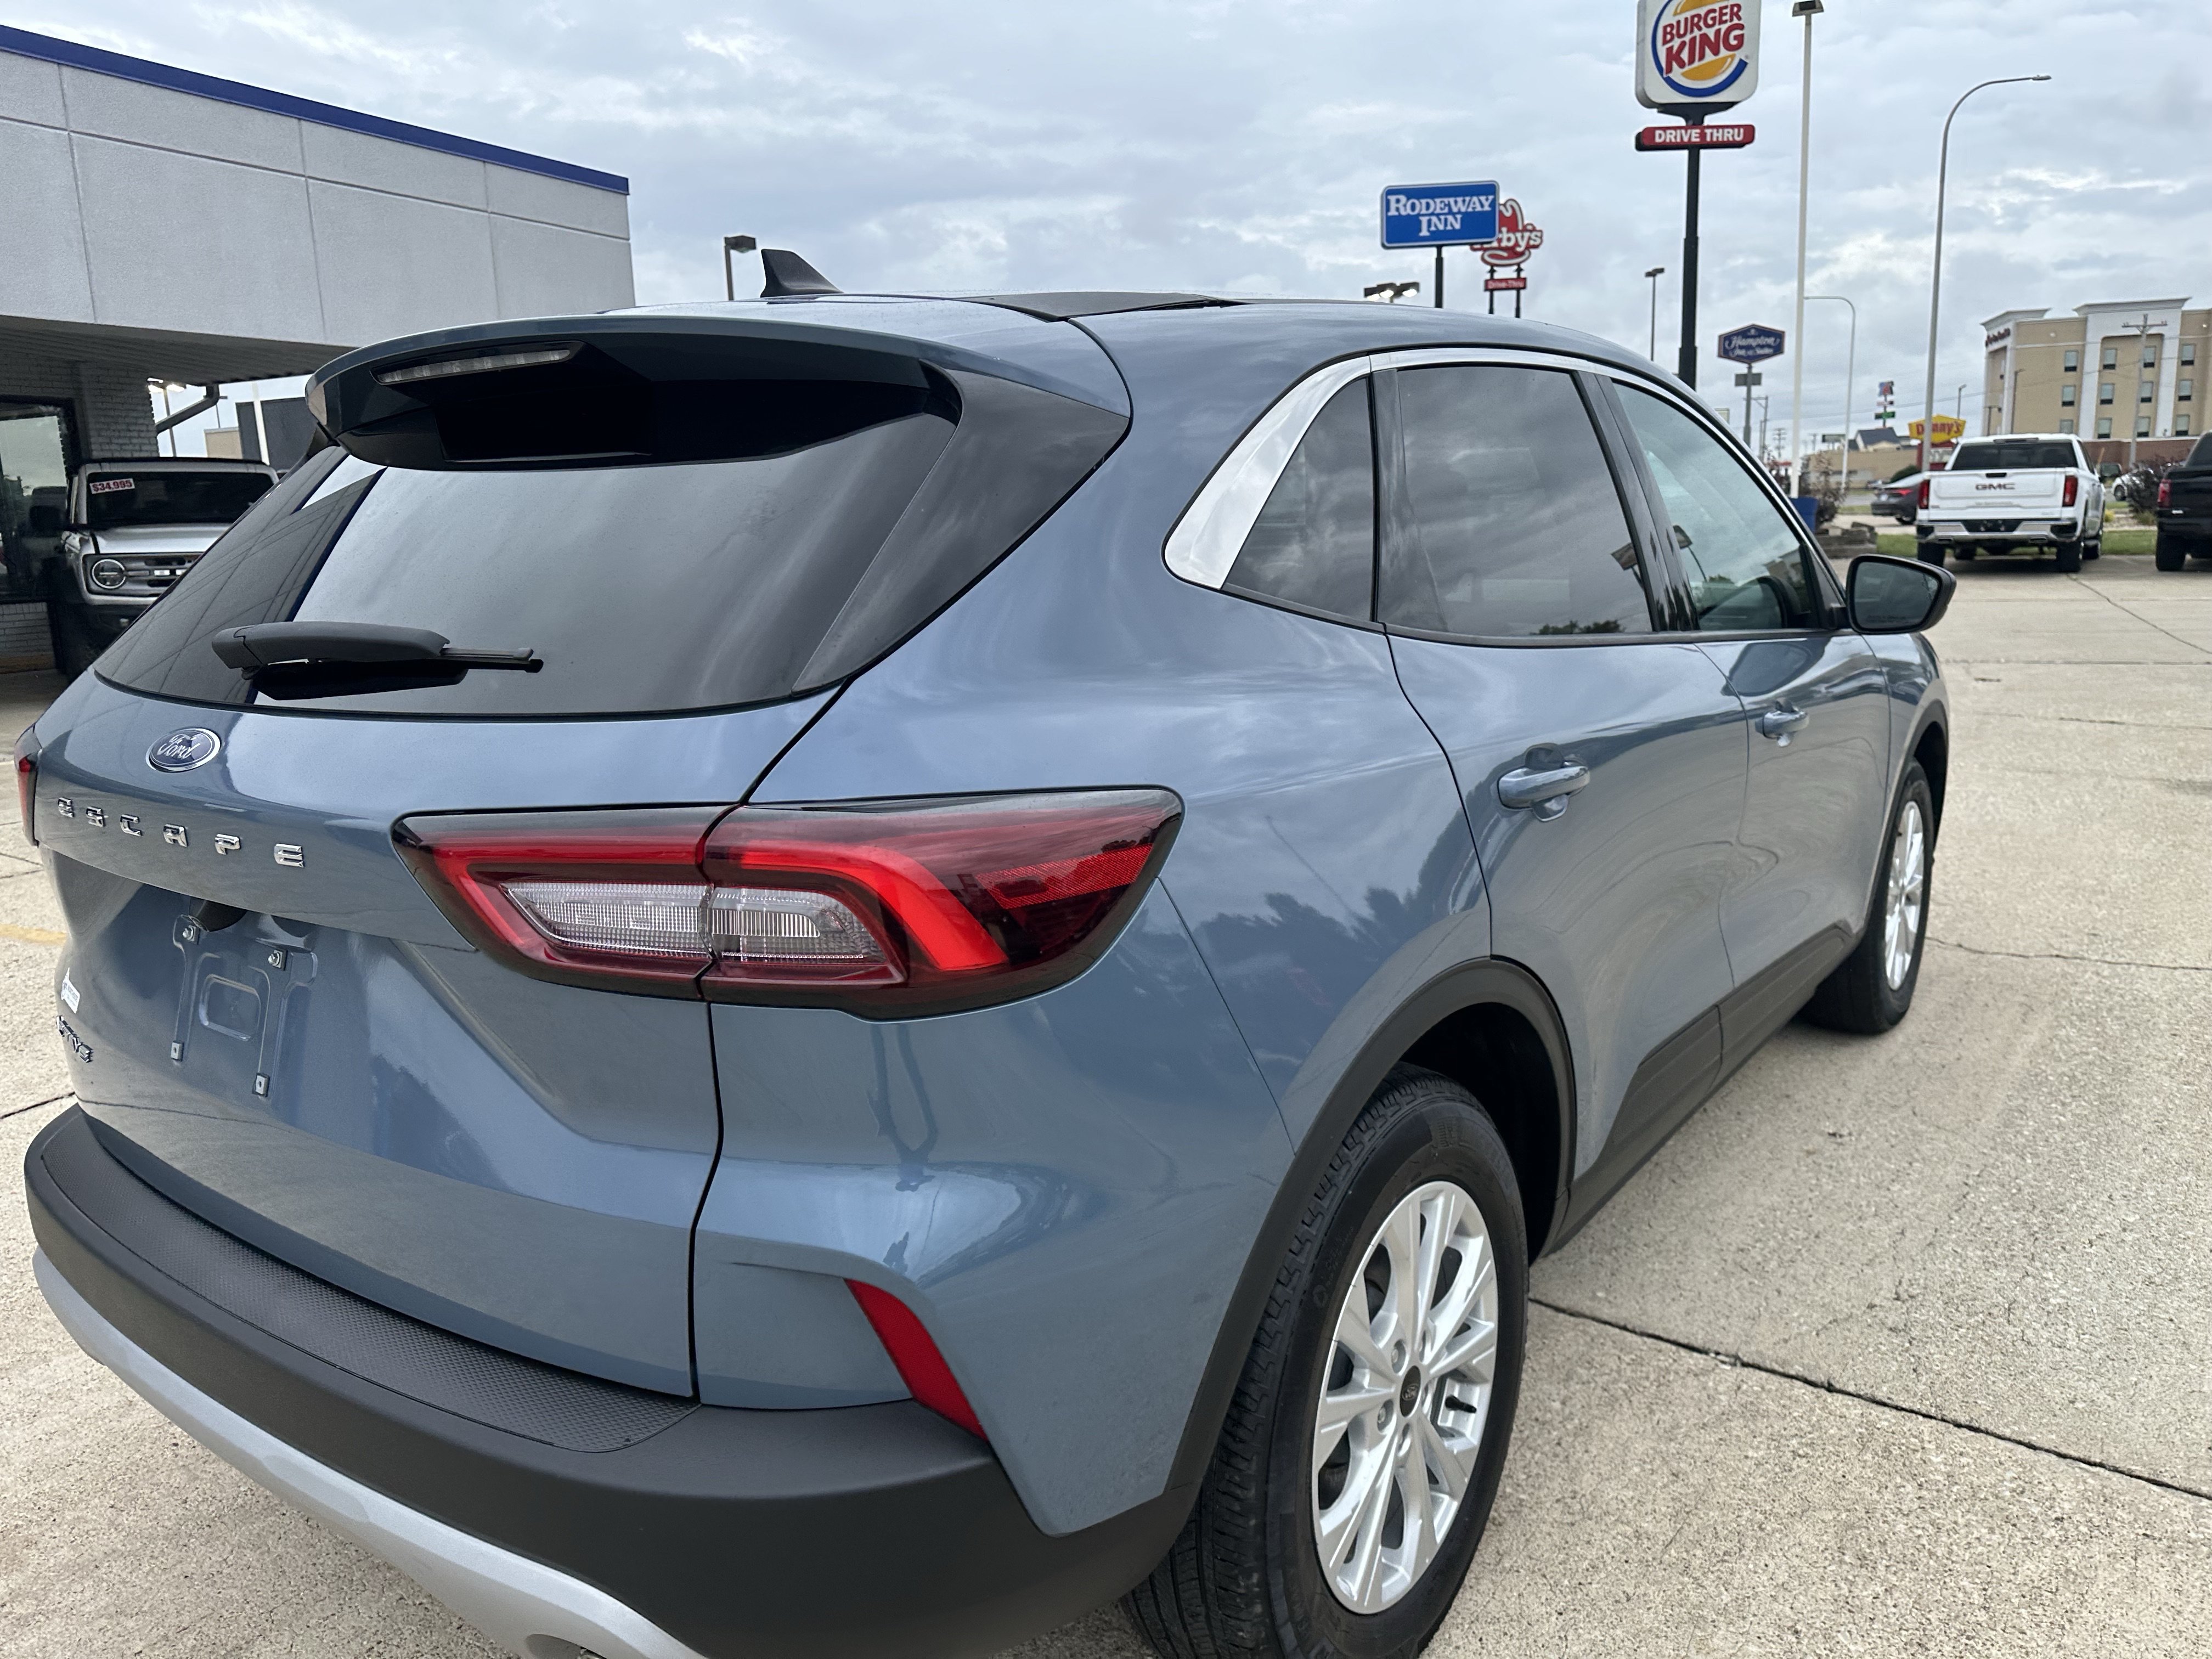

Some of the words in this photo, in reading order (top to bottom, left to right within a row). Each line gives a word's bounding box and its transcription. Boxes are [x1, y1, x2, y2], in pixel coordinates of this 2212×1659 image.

[1662, 3, 1742, 46] BURGER
[1665, 22, 1745, 75] KING
[1655, 129, 1701, 143] DRIVE
[1704, 128, 1744, 141] THRU
[1387, 194, 1494, 217] RODEWAY
[1418, 215, 1463, 236] INN
[1724, 335, 1780, 349] Hampton
[1916, 421, 1962, 436] Dnny's
[1976, 482, 2016, 491] GMC
[157, 733, 201, 760] Ford
[58, 797, 305, 867] ESCAPE
